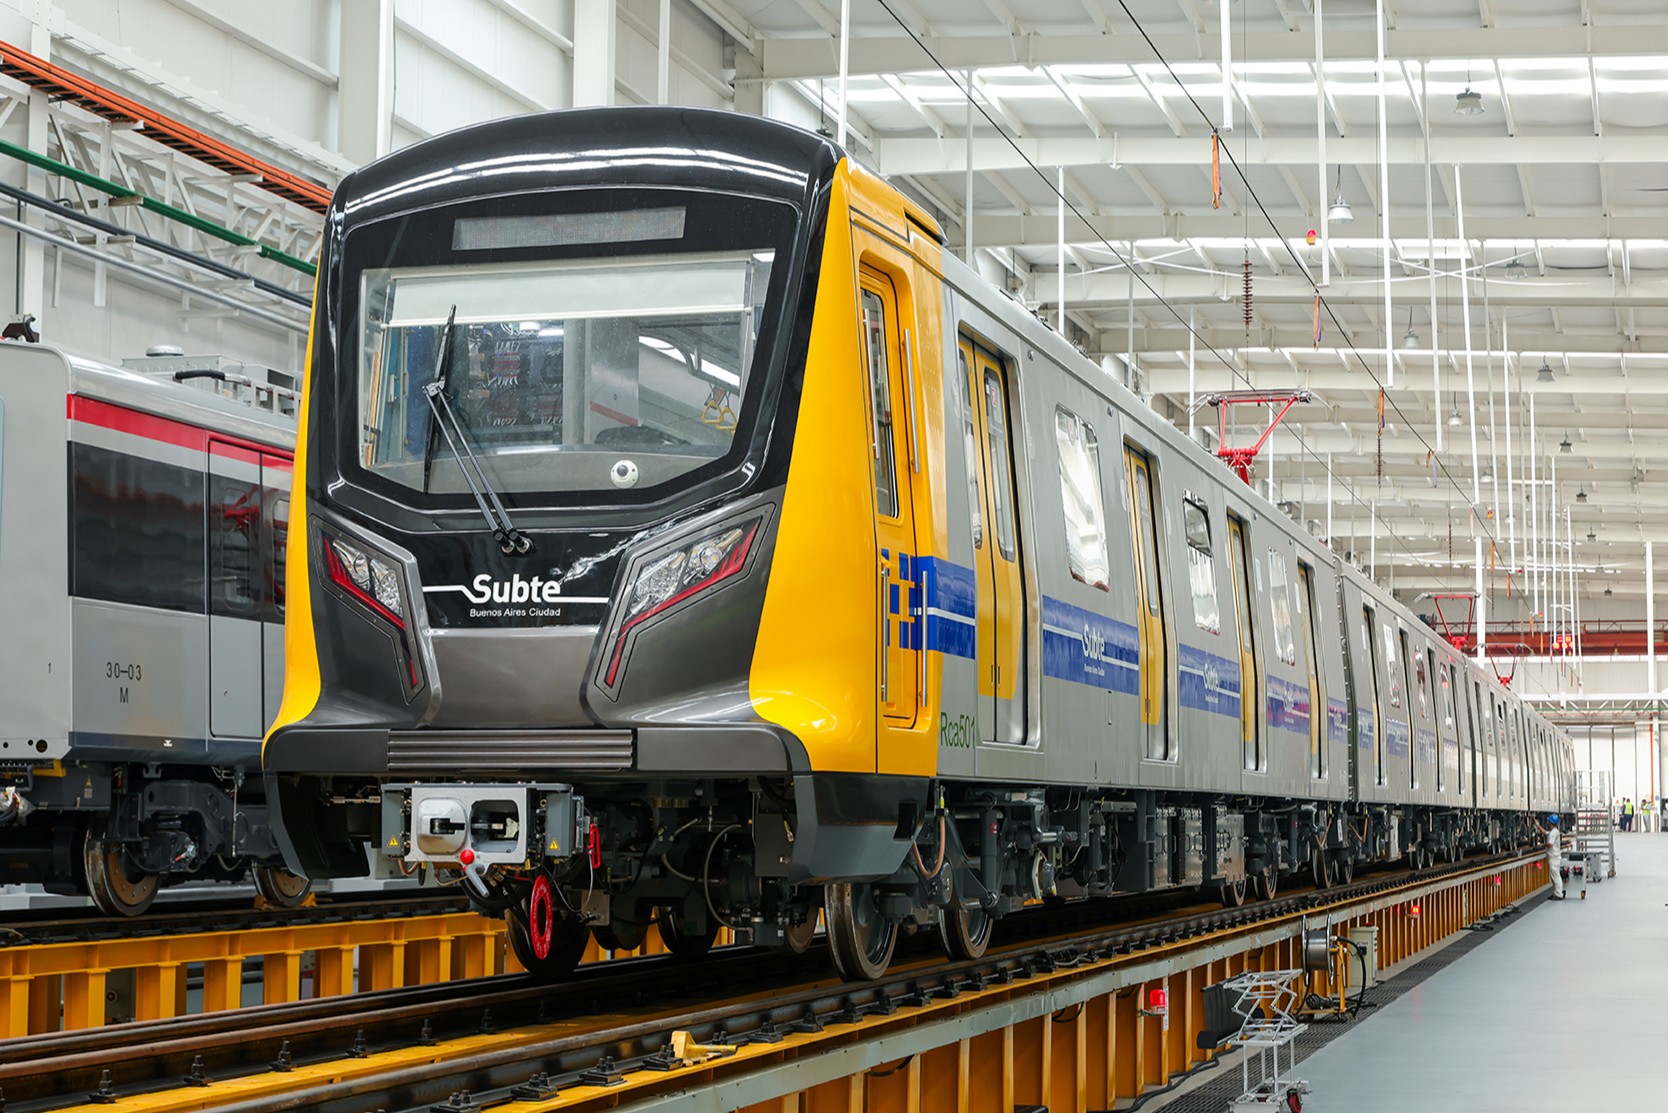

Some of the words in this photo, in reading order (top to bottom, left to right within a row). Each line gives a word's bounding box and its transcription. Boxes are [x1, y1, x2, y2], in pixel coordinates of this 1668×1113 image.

[472, 573, 561, 604] Subte
[469, 608, 502, 618] Buenos
[503, 607, 527, 617] Aires
[528, 607, 561, 617] Ciudad
[1082, 623, 1105, 661] Subte
[106, 661, 142, 681] 30-03
[119, 686, 129, 703] M
[940, 711, 976, 749] Rca501
